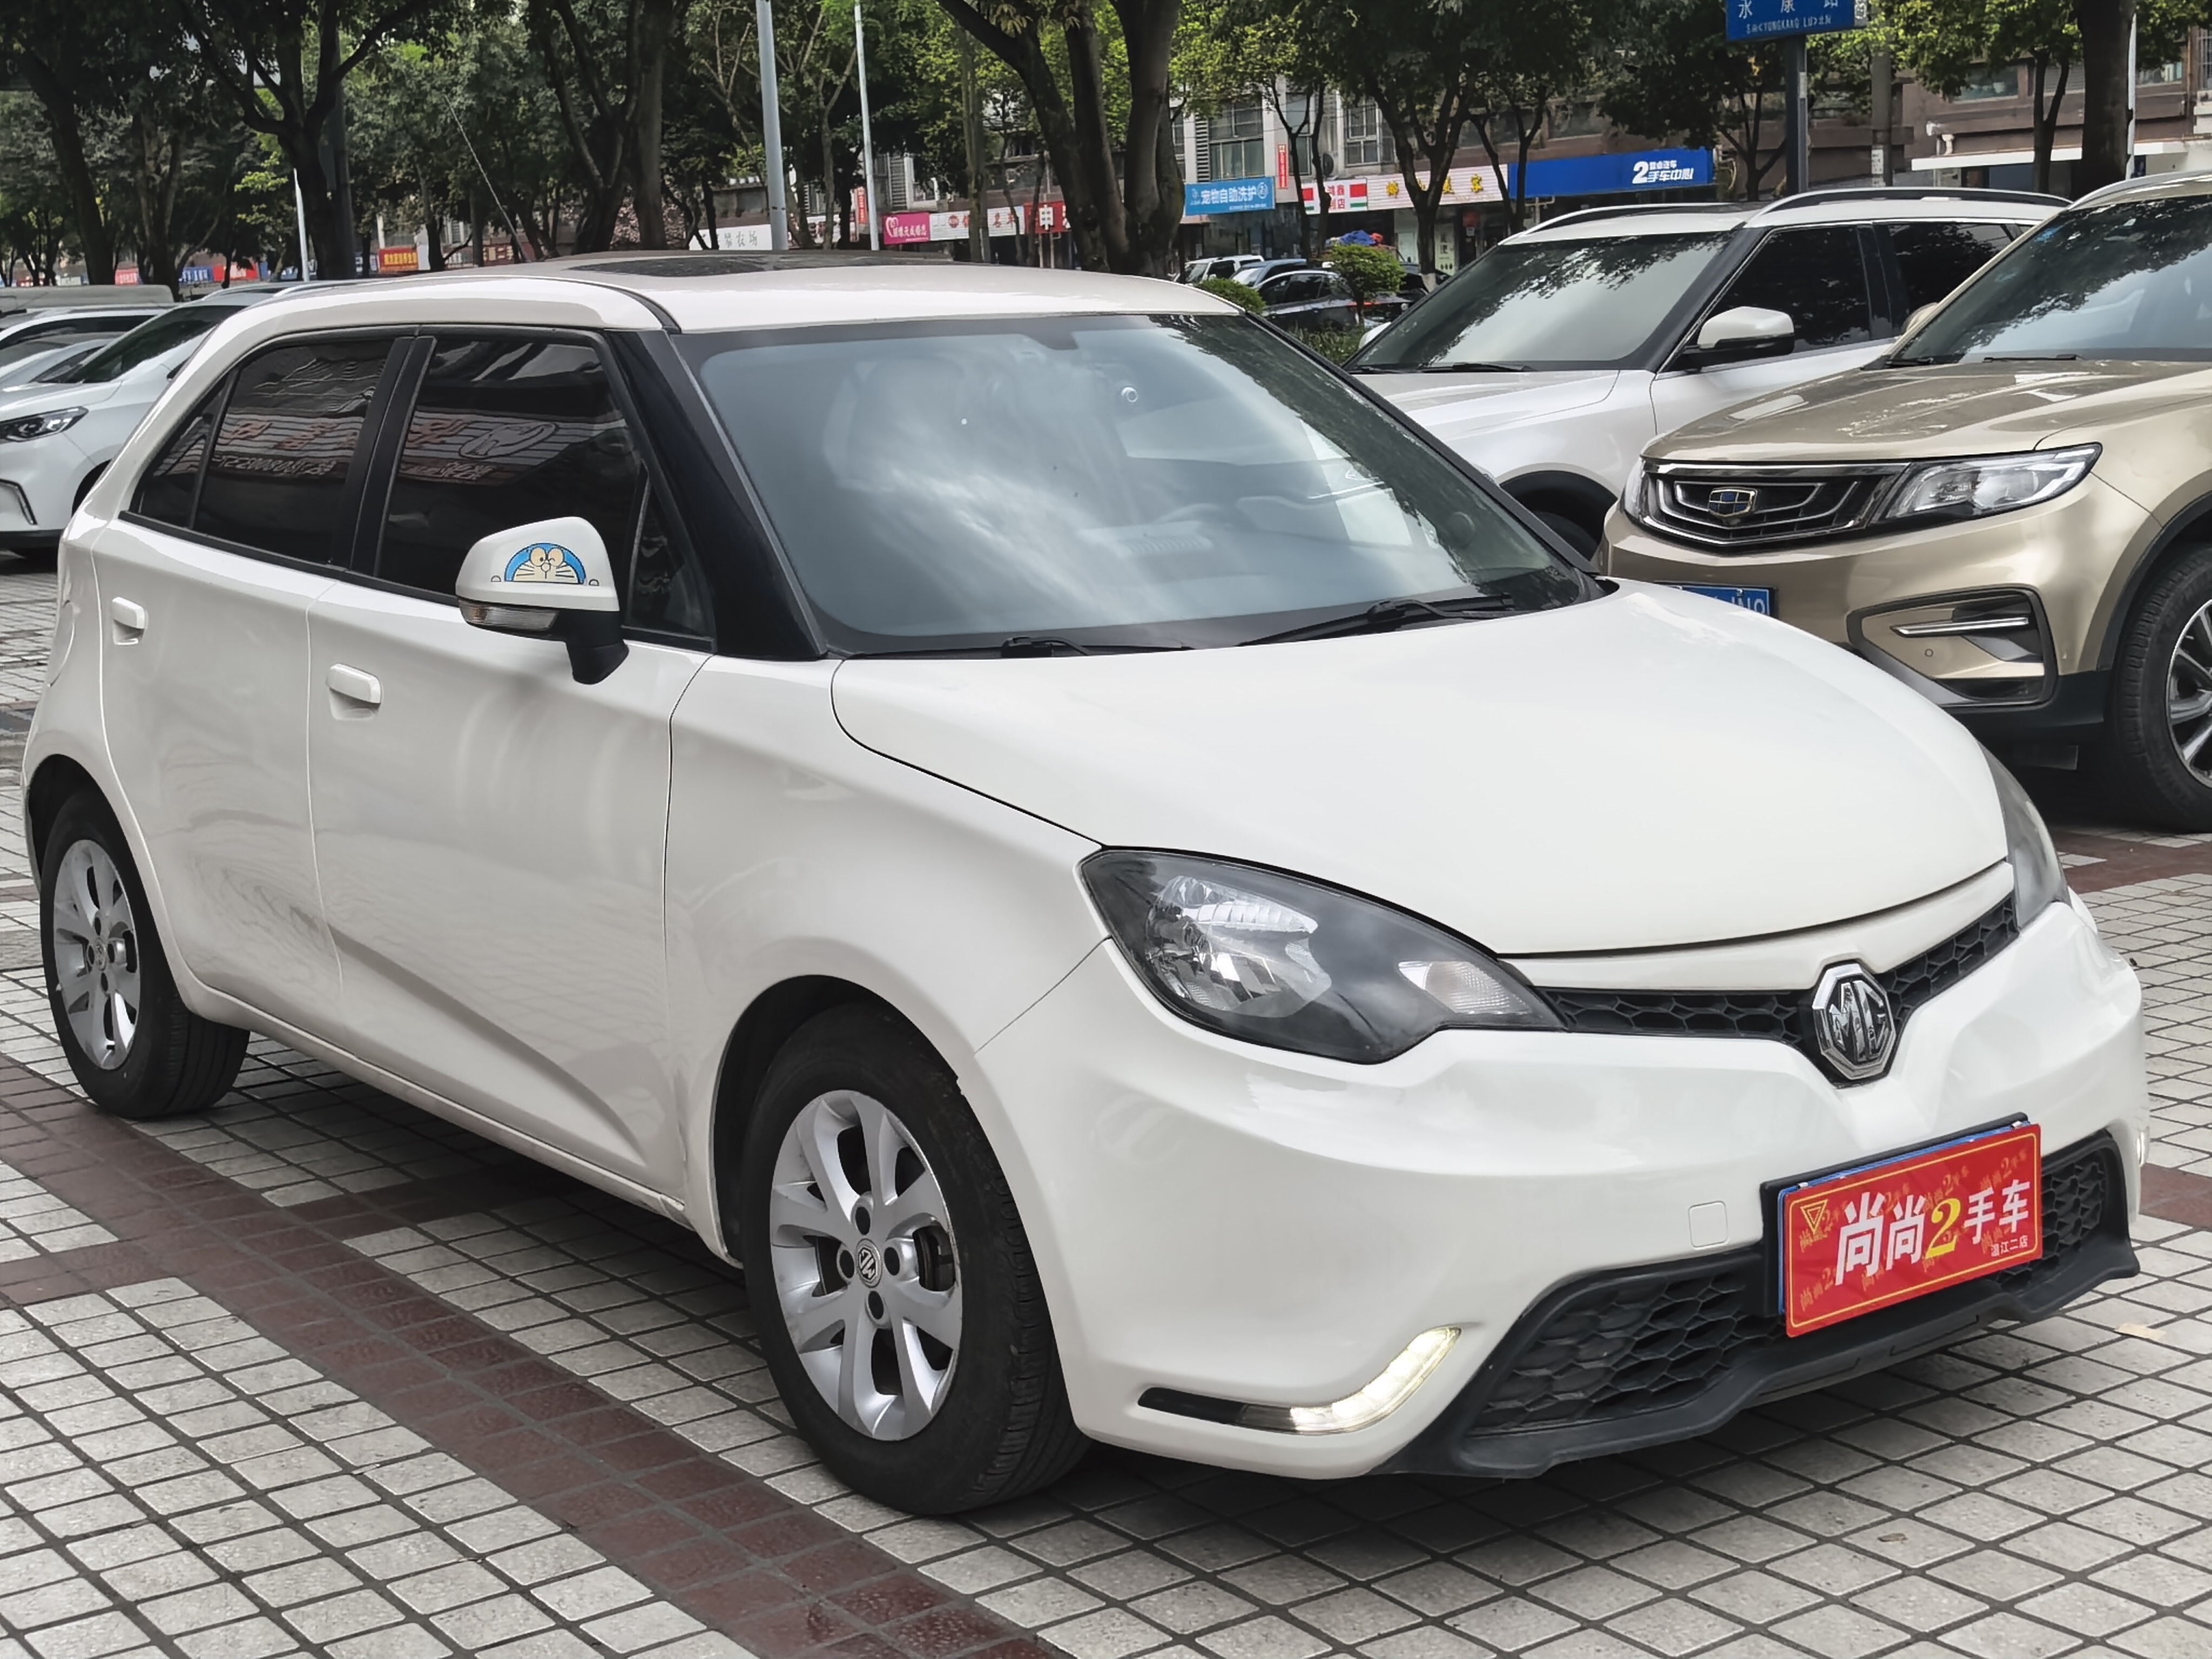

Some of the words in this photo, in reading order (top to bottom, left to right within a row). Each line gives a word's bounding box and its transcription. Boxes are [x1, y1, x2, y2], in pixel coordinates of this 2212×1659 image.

[1829, 980, 1887, 1062] MG
[1835, 1179, 2031, 1286] 尚尚2手车
